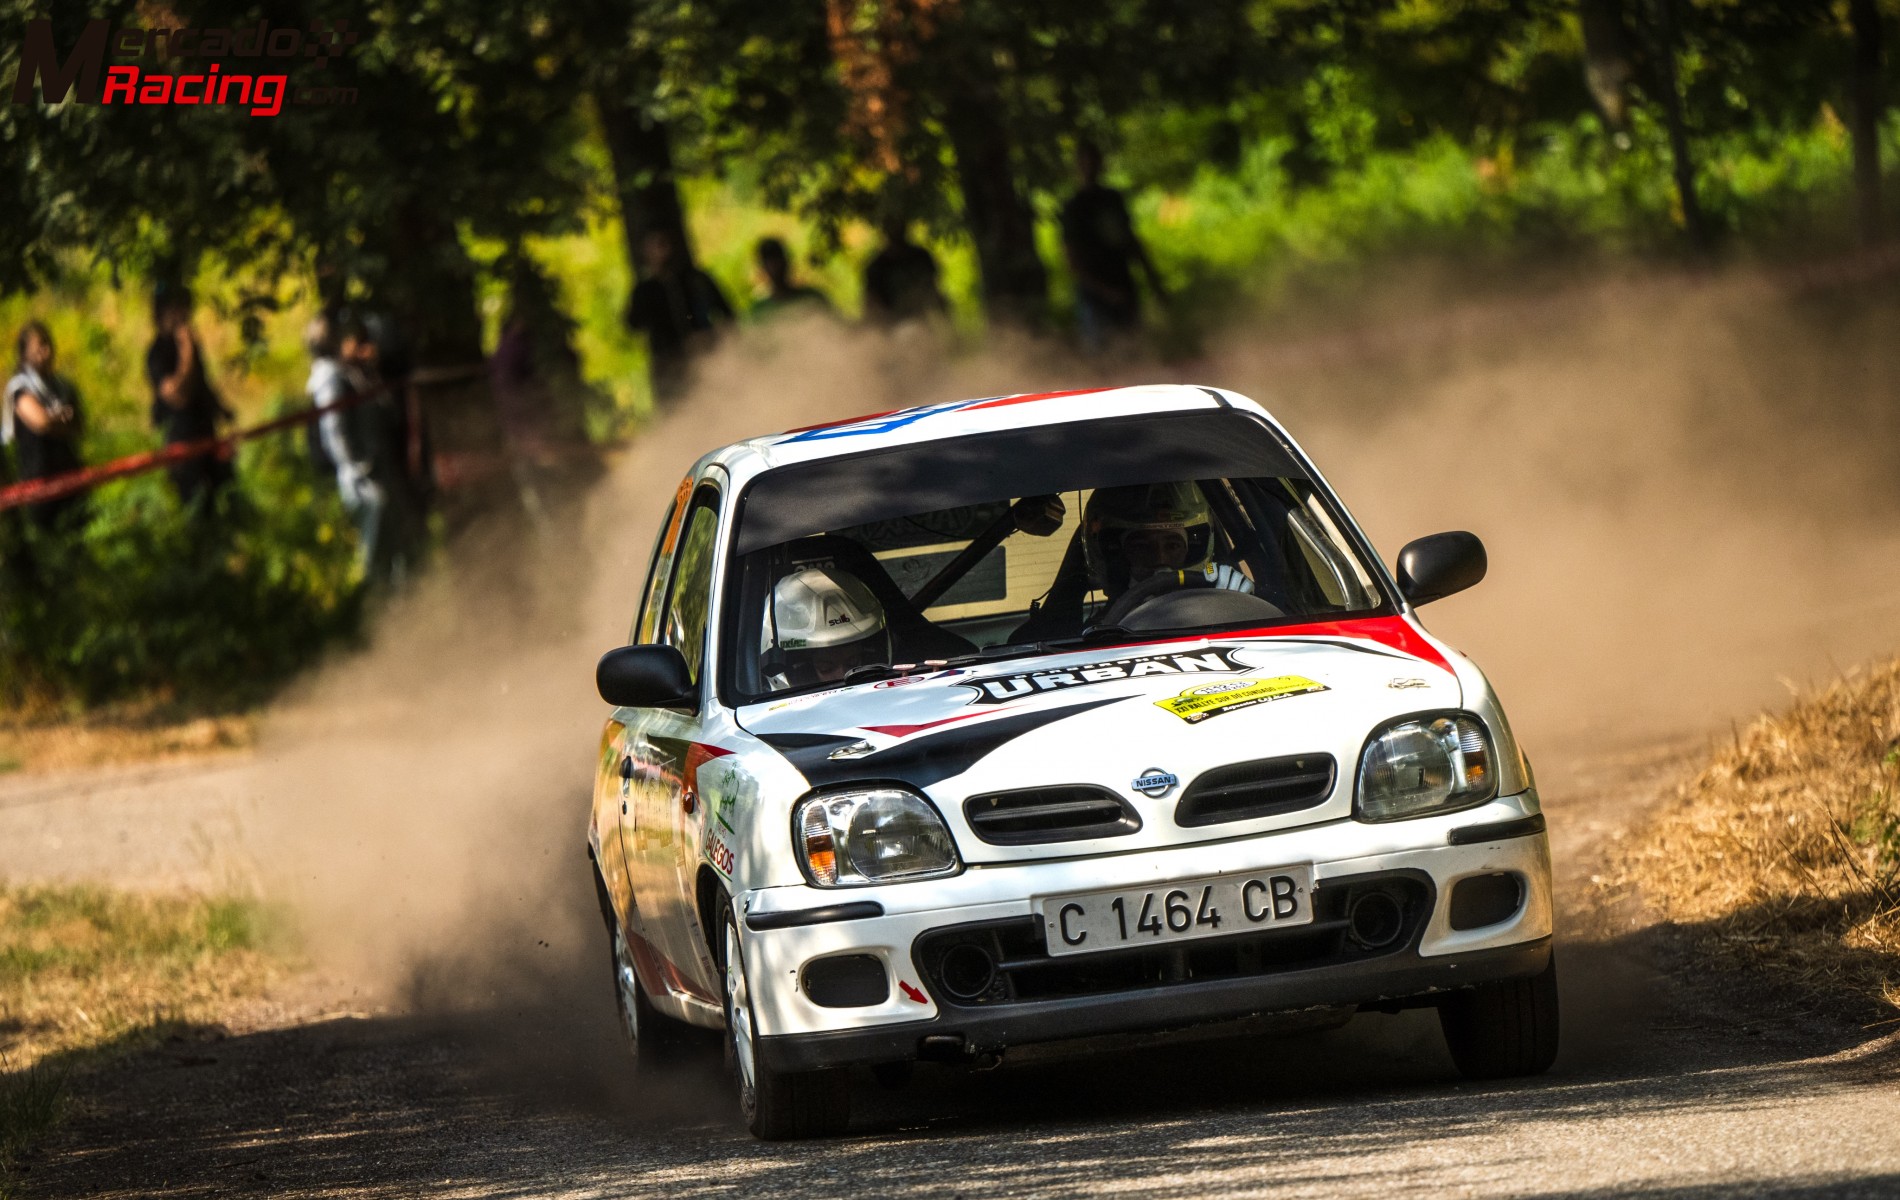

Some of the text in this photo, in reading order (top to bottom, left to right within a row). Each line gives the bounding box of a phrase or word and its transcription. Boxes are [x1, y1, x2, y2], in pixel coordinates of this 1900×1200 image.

[982, 653, 1233, 699] URBAN
[1189, 699, 1215, 712] RALLYE
[1136, 776, 1171, 787] NISSAN
[705, 828, 735, 876] GALEGOS
[1059, 875, 1298, 945] C 1464 CB
